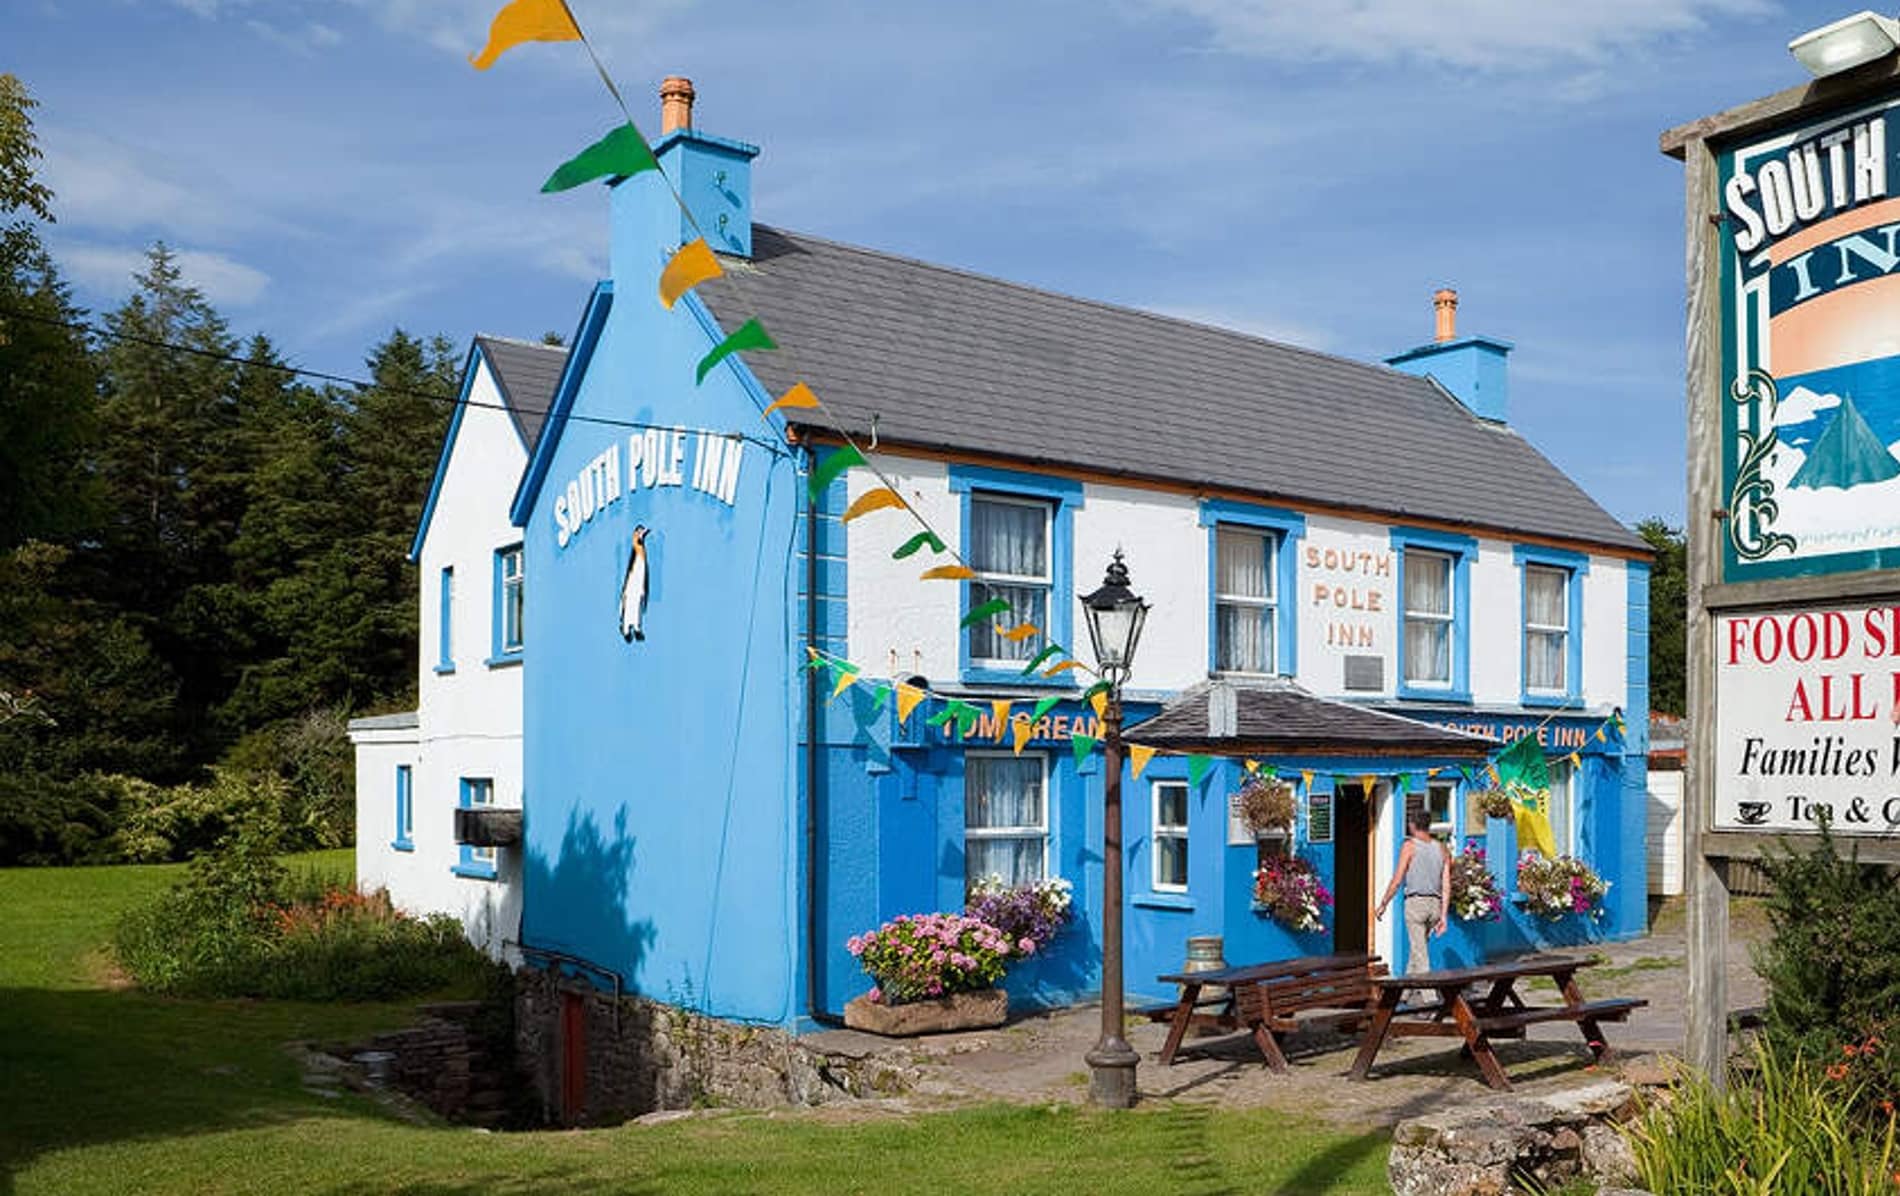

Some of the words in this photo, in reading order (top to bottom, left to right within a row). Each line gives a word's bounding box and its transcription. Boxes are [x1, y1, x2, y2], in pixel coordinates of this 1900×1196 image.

[1725, 117, 1887, 252] SOUTH
[554, 444, 620, 548] SOUTH
[628, 425, 686, 491] POLE
[692, 428, 744, 507] INN
[1306, 546, 1390, 577] SOUTH
[1313, 584, 1383, 612] POLE
[1326, 622, 1374, 648] INN
[1727, 611, 1850, 665] FOOD
[1785, 672, 1878, 722] ALL
[1554, 727, 1586, 747] INN
[1738, 736, 1879, 778] Families
[1845, 797, 1870, 823] &
